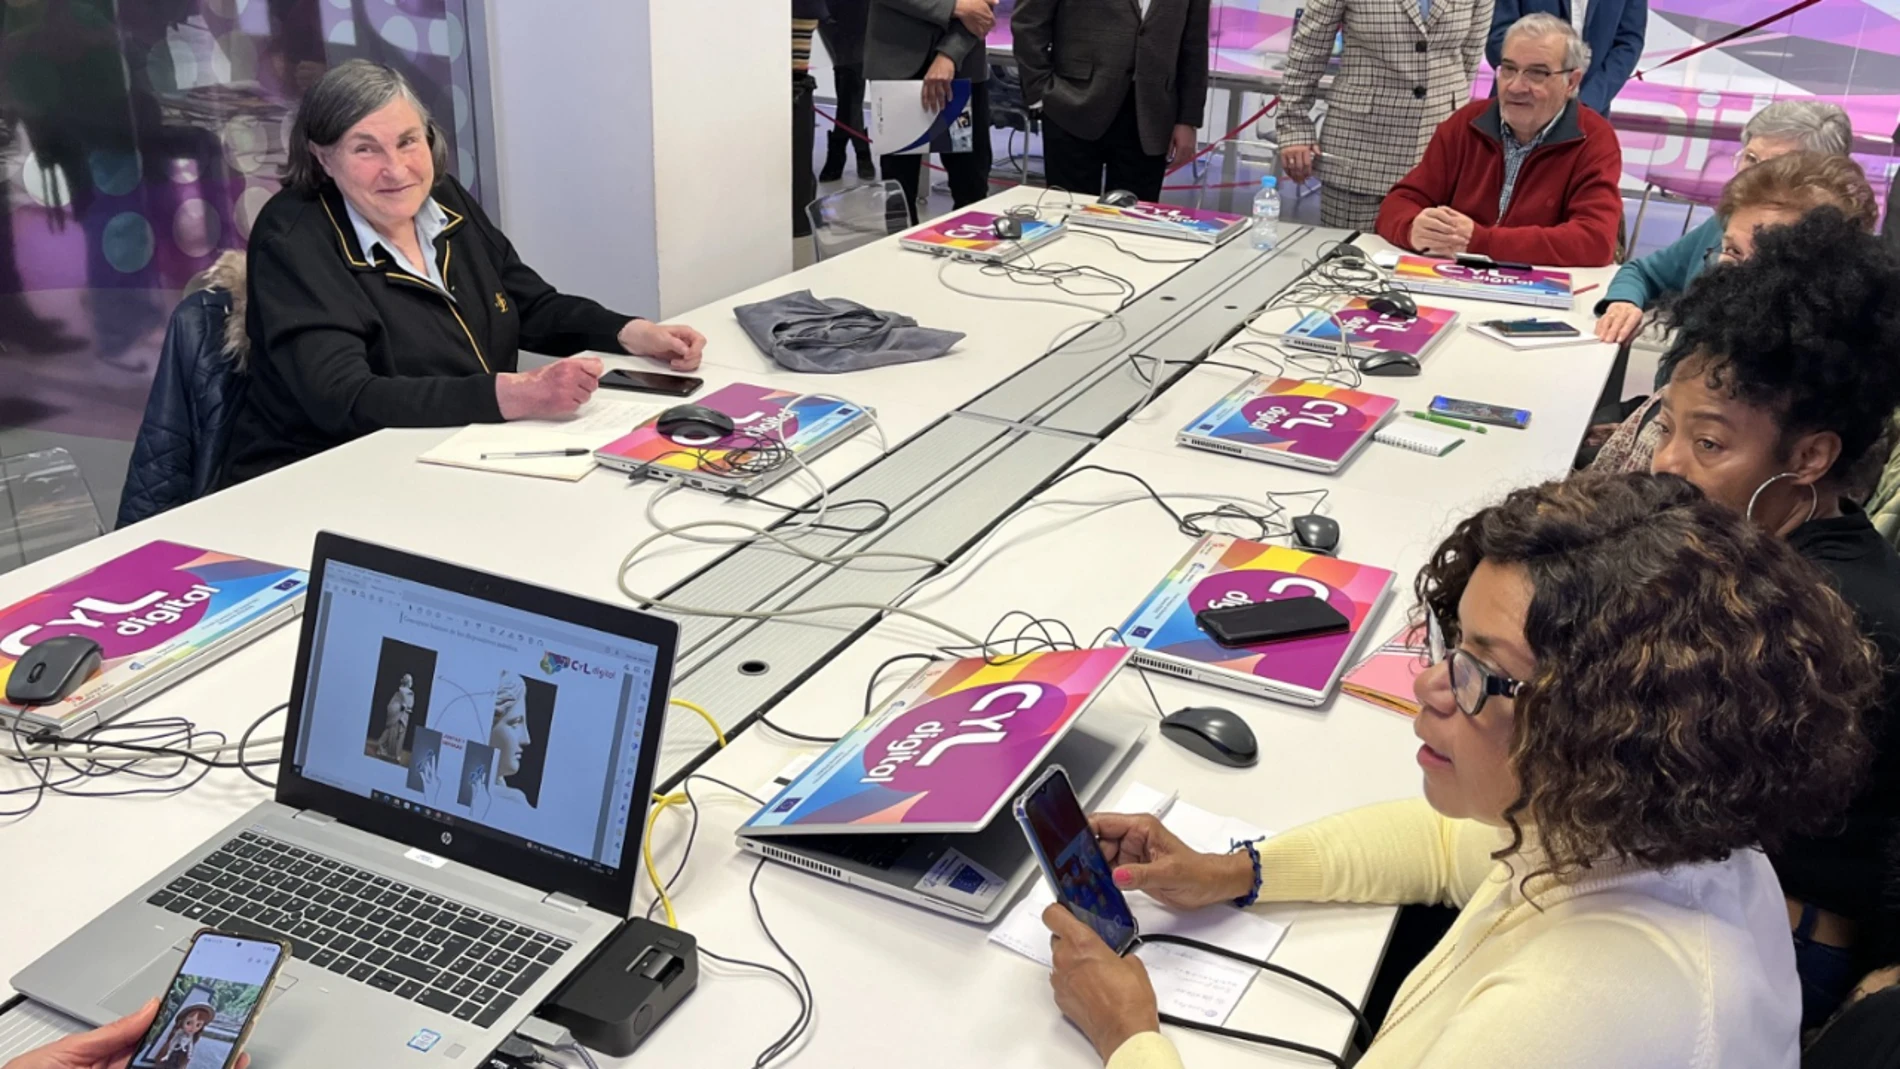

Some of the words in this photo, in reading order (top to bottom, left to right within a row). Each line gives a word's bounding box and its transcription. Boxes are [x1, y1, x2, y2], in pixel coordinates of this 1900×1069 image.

[1248, 406, 1290, 432] digital
[1281, 400, 1349, 430] CYL
[0, 590, 169, 656] CYL
[116, 584, 221, 636] digital
[859, 721, 944, 783] digital
[915, 683, 1043, 767] CYL
